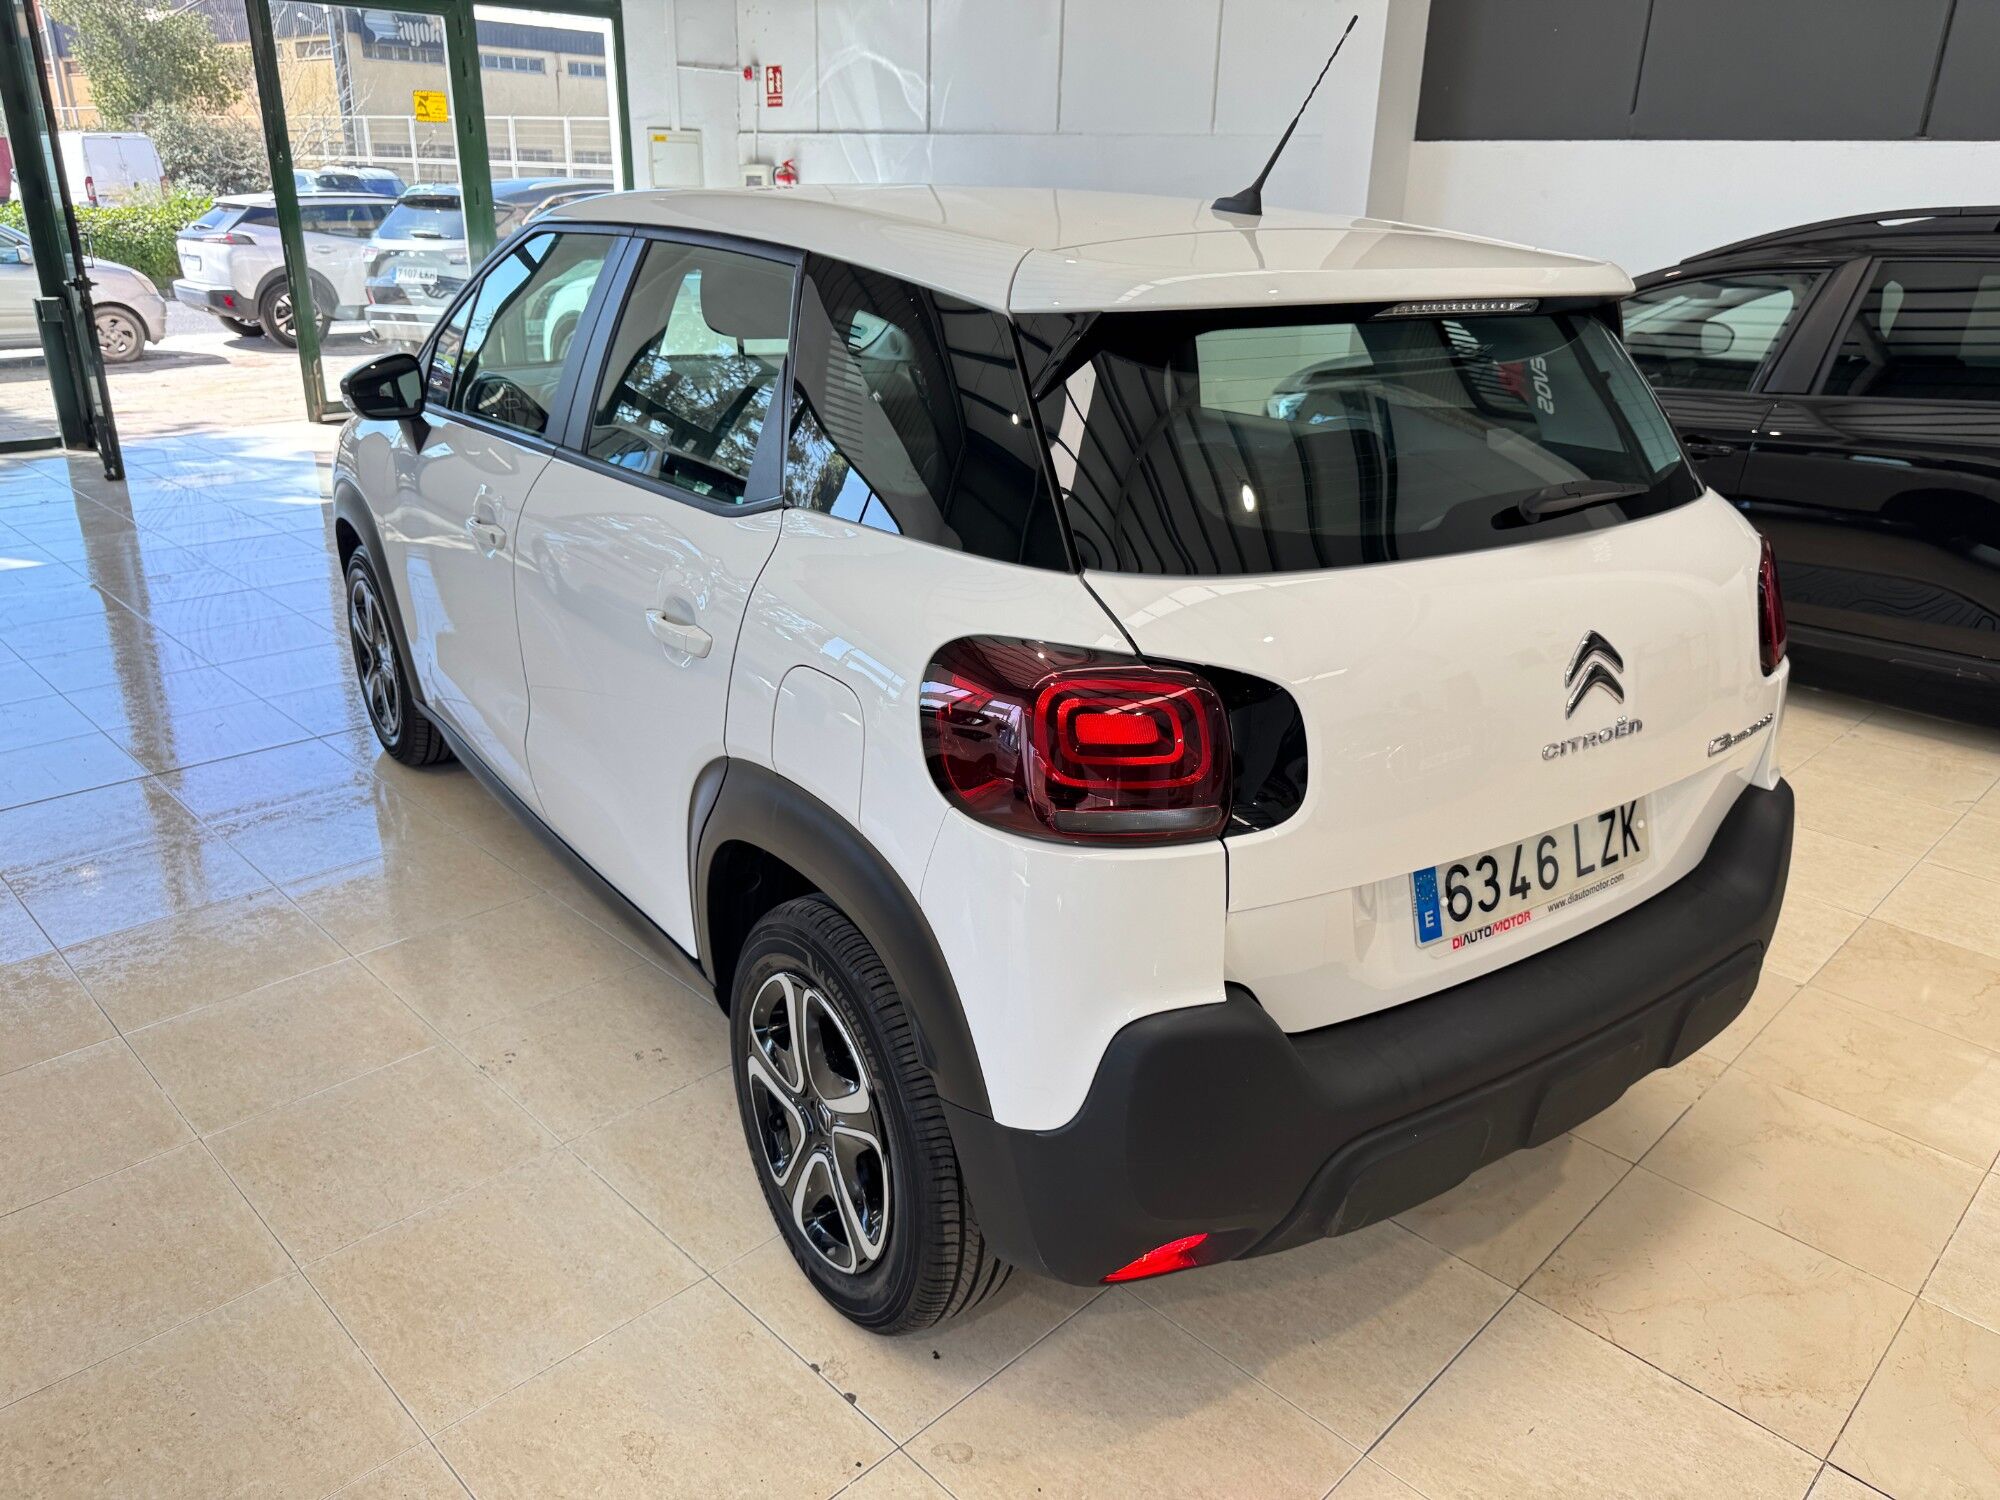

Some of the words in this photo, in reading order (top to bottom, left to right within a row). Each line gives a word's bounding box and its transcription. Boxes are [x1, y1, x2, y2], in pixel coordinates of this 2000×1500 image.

[1444, 835, 1560, 923] 6346
[1573, 800, 1641, 878] LZK
[1547, 872, 1625, 913] www.diautomotor.com
[1424, 910, 1435, 928] E
[1452, 910, 1532, 950] DIAUTOMOTOR
